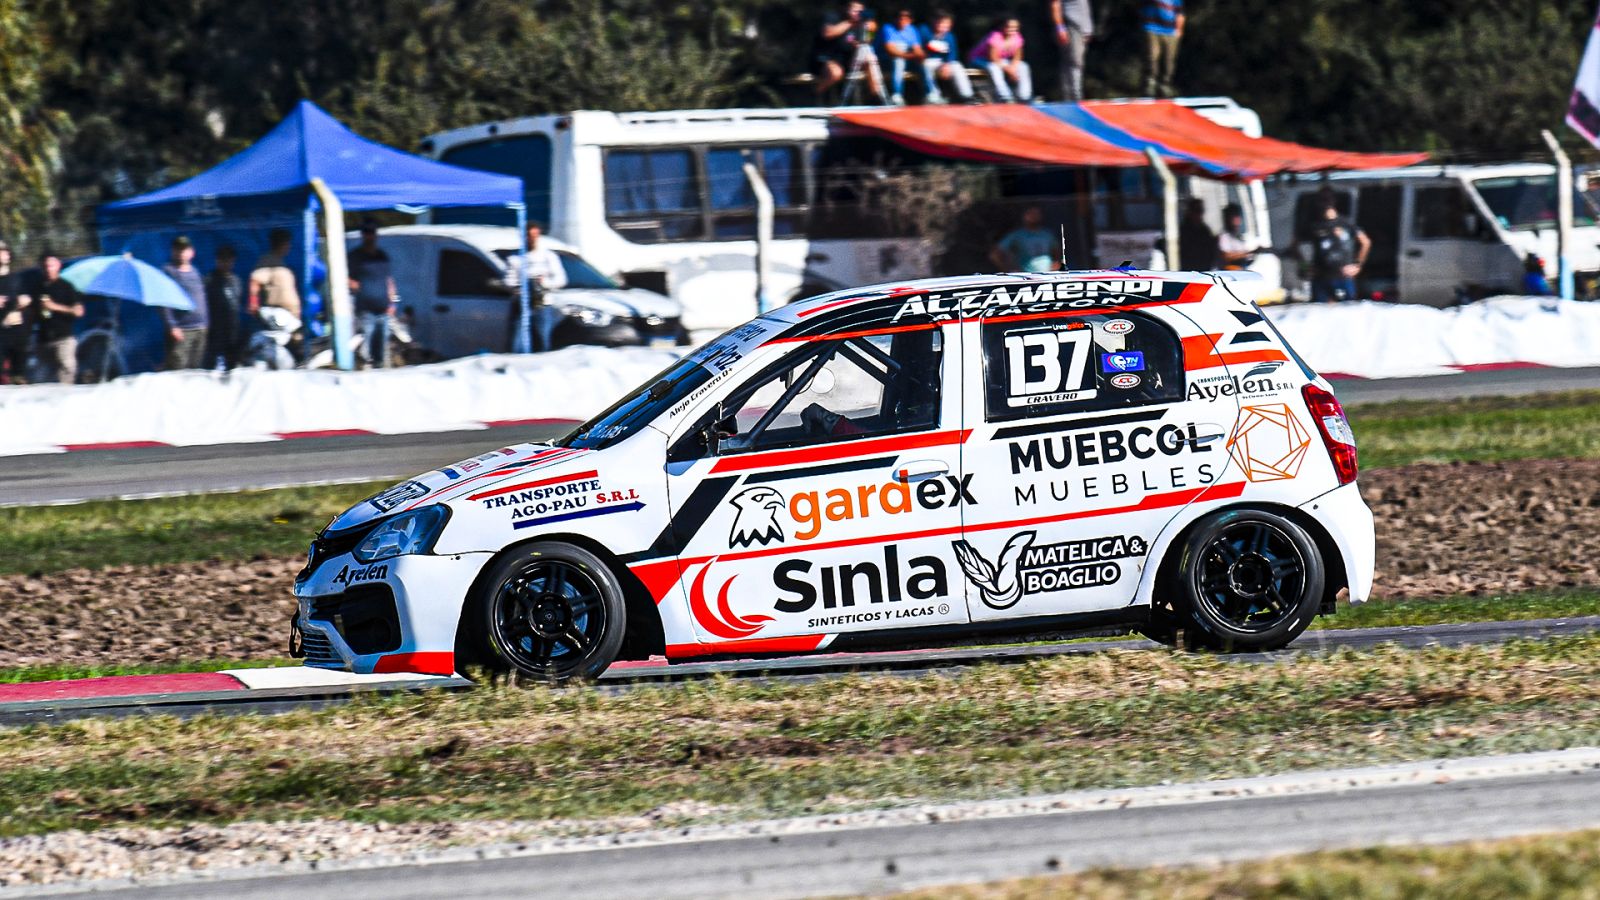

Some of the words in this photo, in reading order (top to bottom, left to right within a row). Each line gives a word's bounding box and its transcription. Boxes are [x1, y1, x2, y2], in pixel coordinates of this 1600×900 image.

[933, 296, 1126, 321] AVIACION
[1004, 329, 1093, 396] 137
[669, 400, 690, 419] Alejo
[691, 376, 721, 401] Cravero
[1027, 393, 1078, 404] CRAVERO
[1187, 375, 1275, 403] Ayelen
[1009, 422, 1213, 474] MUEBCOL
[483, 479, 602, 509] TRANSPORTE
[1014, 463, 1214, 506] MUEBLES
[511, 496, 587, 519] AGO-PAU
[596, 489, 640, 504] S.R.L
[789, 469, 979, 541] gardex
[1024, 538, 1125, 566] MATELICA
[1130, 539, 1143, 554] &
[332, 563, 388, 587] Ayelen
[773, 544, 949, 613] Sinla
[1027, 565, 1119, 592] BOAGLIO
[808, 611, 881, 628] SINTETICOS
[885, 611, 893, 620] Y
[896, 606, 934, 618] LACAS
